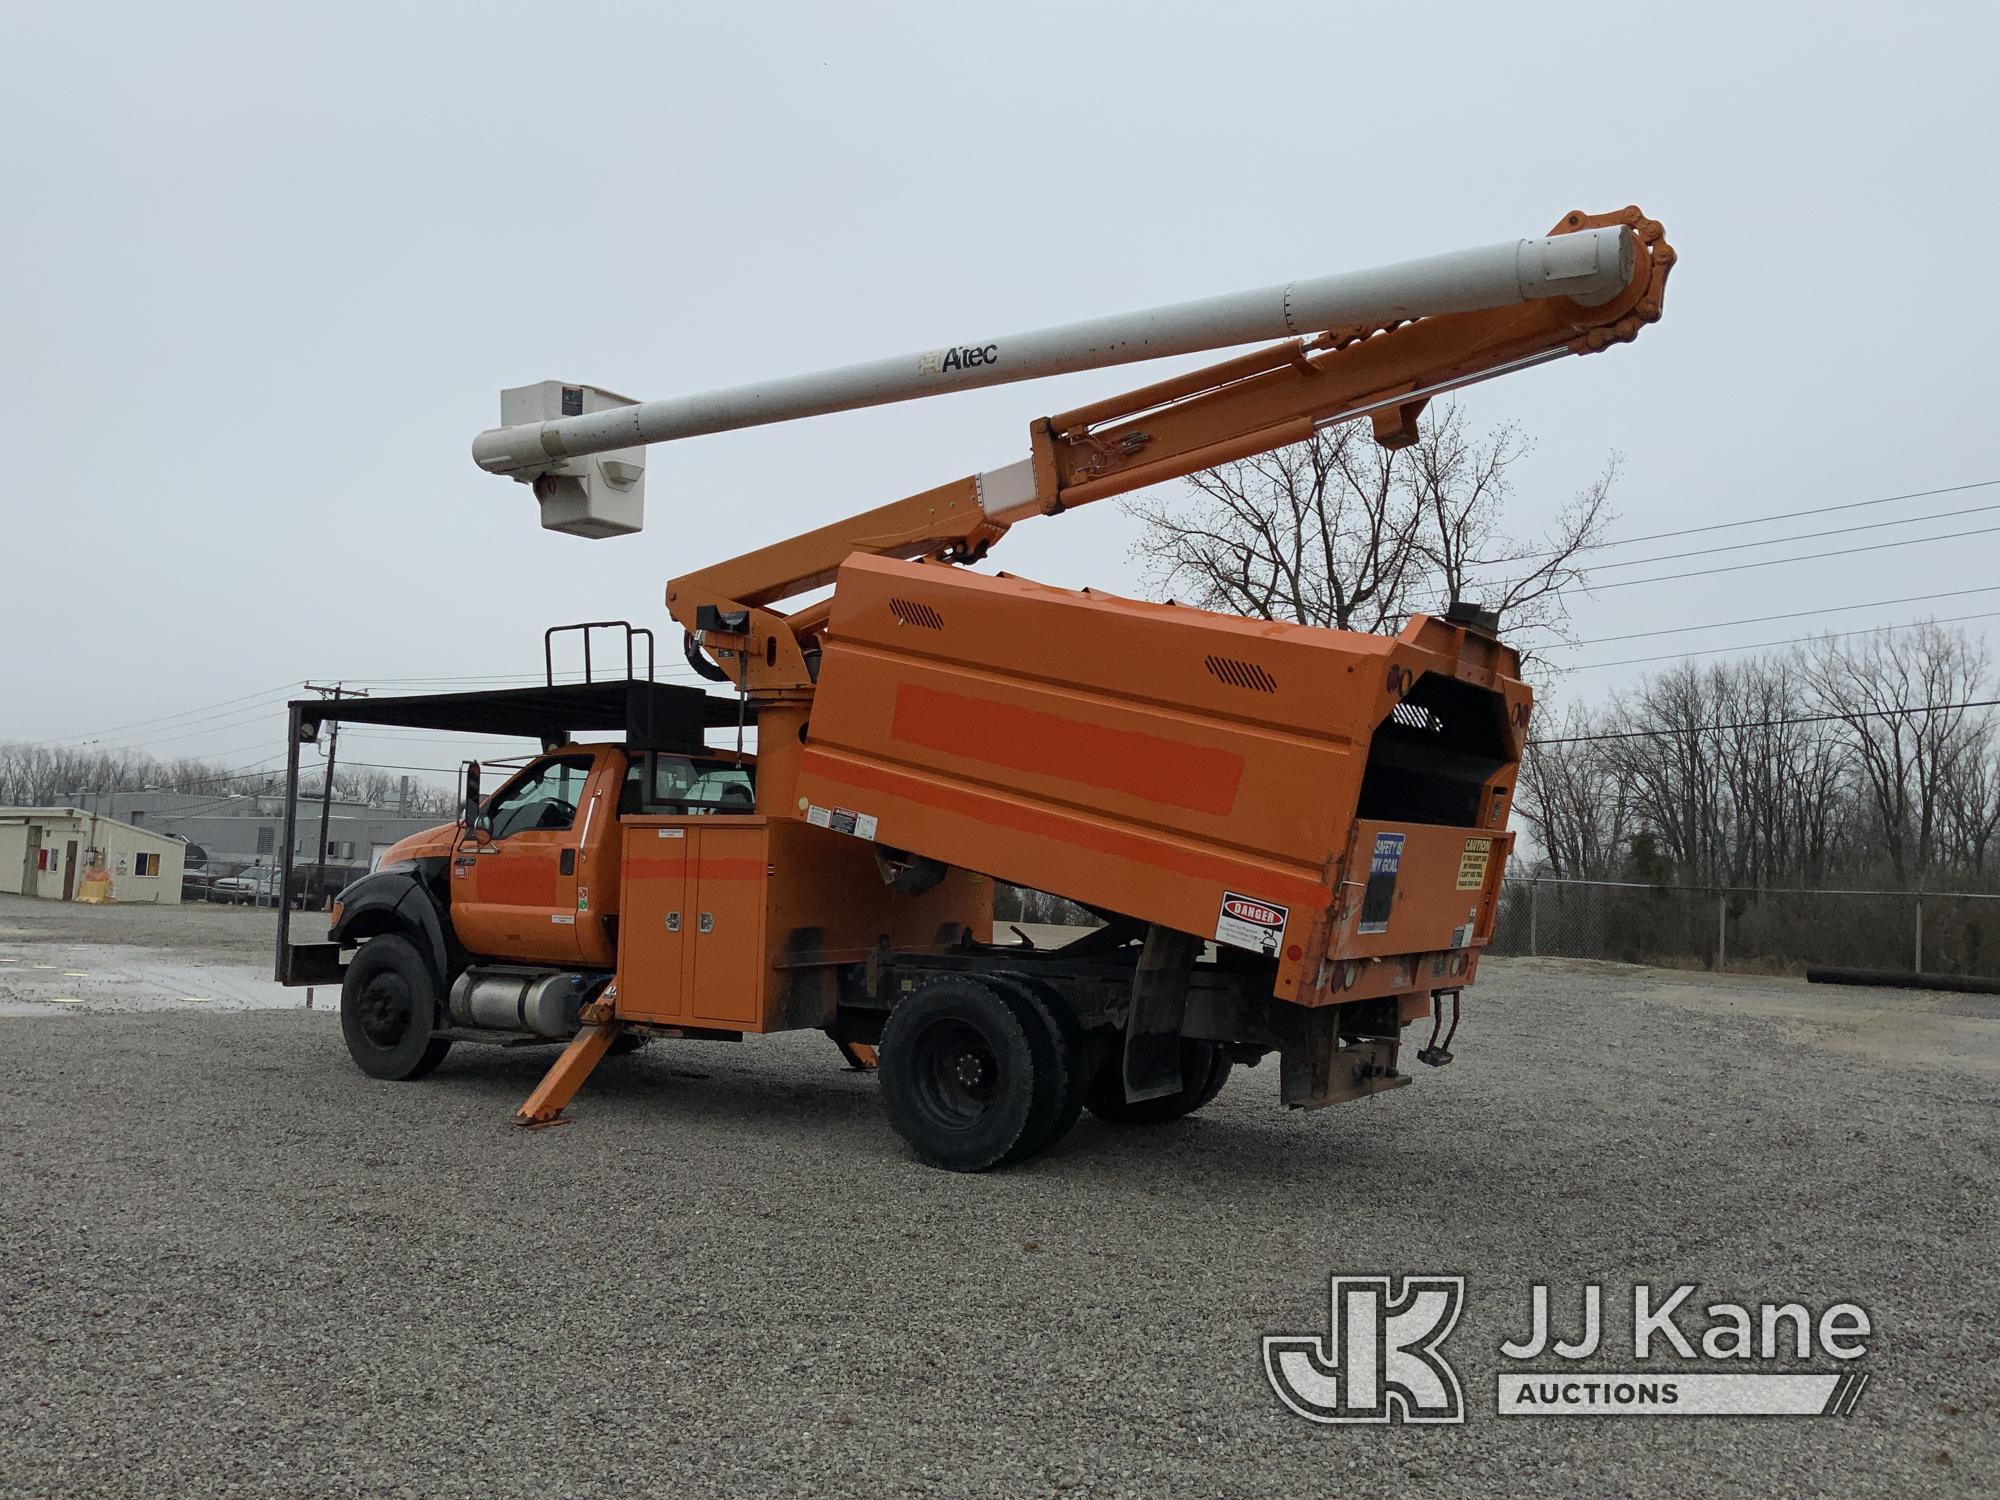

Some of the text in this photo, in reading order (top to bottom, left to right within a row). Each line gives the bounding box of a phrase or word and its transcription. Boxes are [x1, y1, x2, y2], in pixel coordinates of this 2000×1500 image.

[1374, 839, 1399, 855] SAFETY
[1465, 839, 1491, 851] CAUTION
[1371, 858, 1398, 872] MY GOAL
[1234, 903, 1274, 922] DANGER
